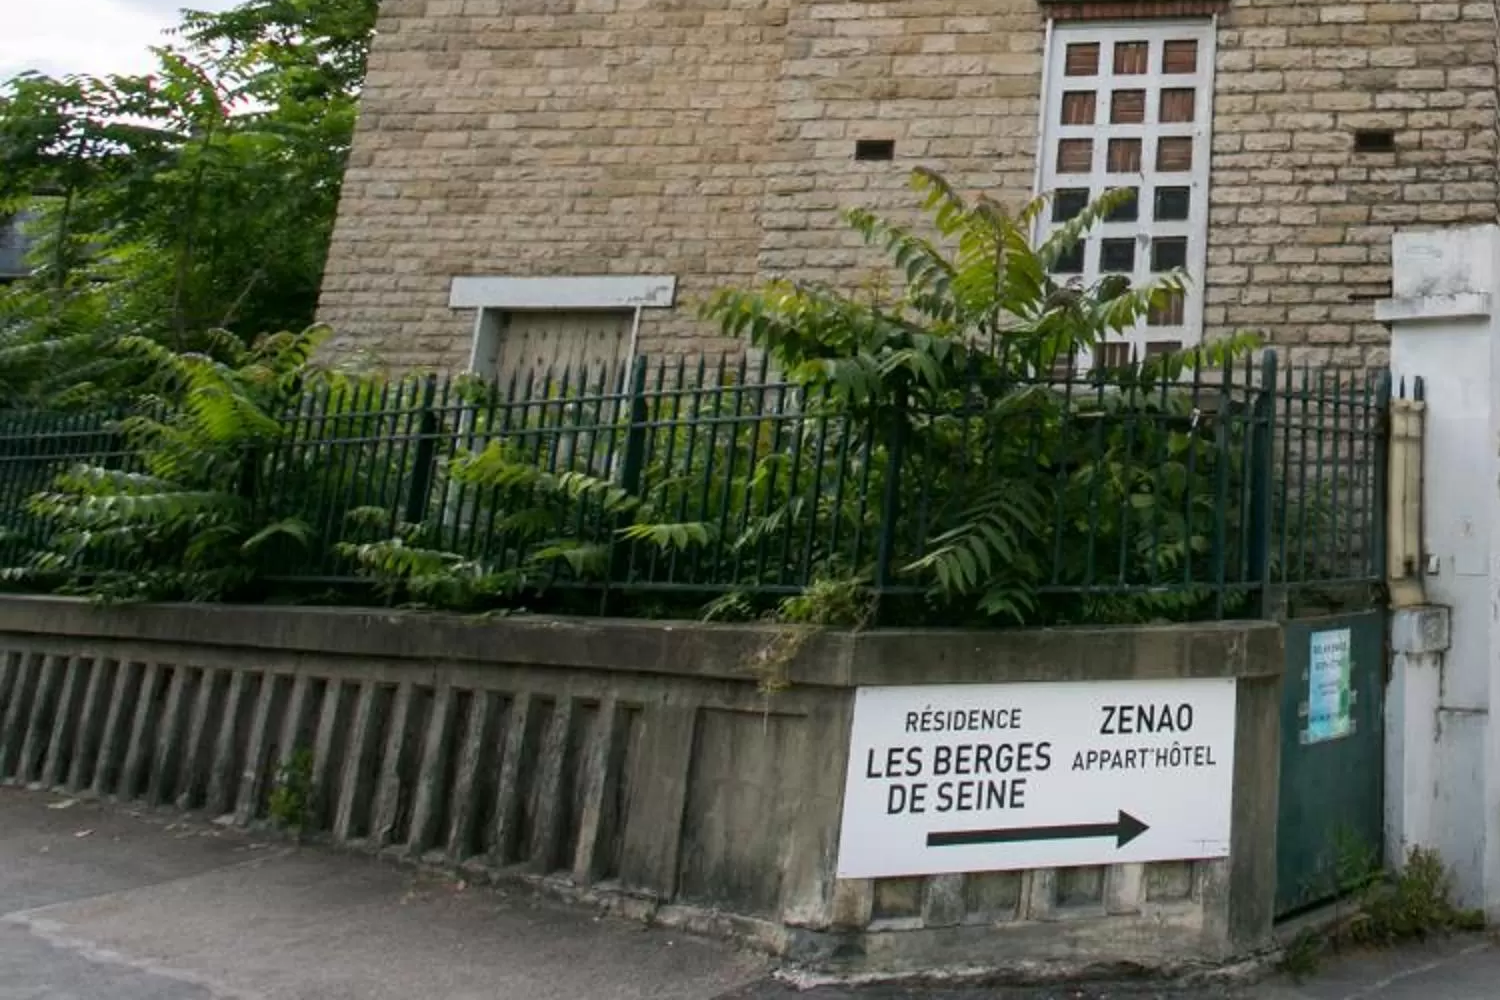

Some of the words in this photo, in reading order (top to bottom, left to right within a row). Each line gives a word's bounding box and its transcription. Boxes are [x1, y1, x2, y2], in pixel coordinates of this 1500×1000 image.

[905, 704, 1022, 733] RÉSIDENCE
[1100, 703, 1194, 735] ZENAO
[866, 746, 923, 779] LES
[933, 742, 1051, 776] BERGES
[1071, 741, 1217, 771] APPART'HÔTEL
[887, 783, 928, 815] DE
[935, 778, 1027, 812] SEINE
